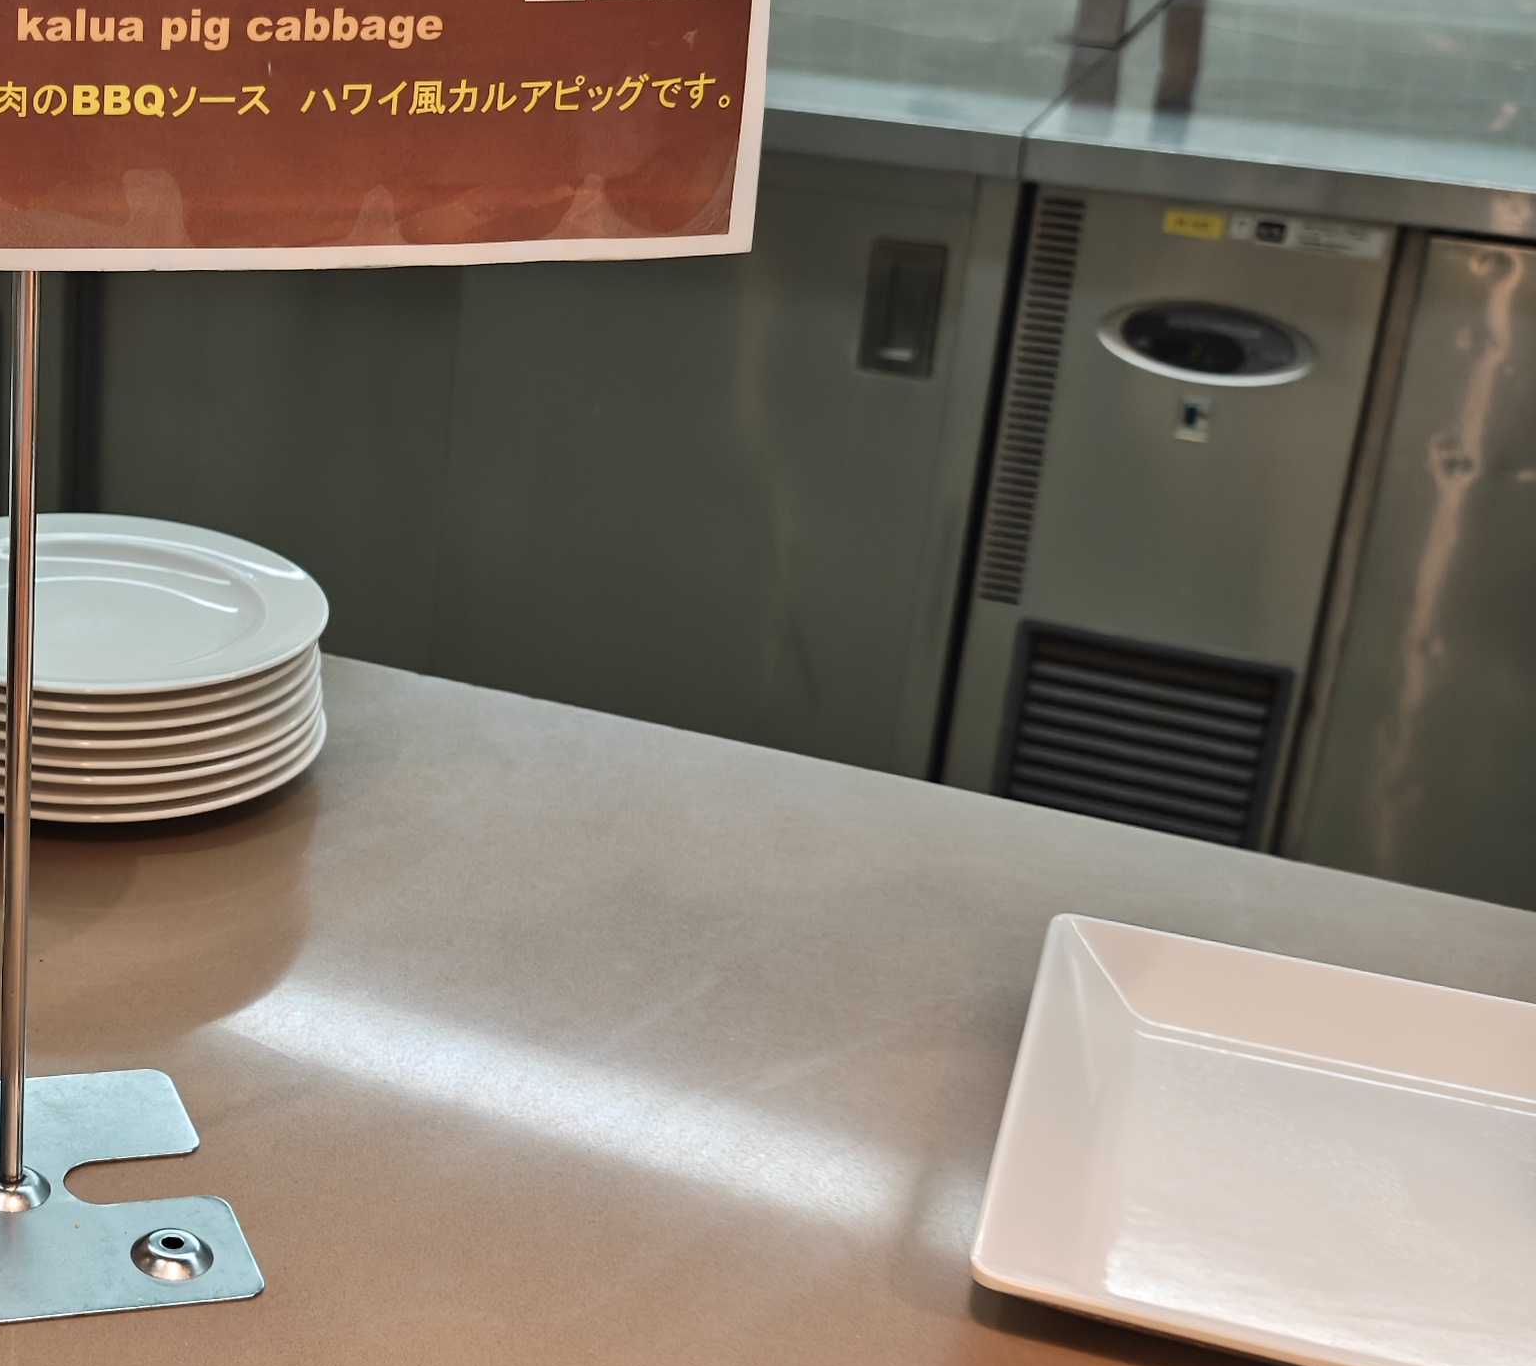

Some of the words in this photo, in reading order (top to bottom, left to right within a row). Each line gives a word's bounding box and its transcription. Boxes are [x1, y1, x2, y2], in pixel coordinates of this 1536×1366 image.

[17, 8, 144, 42] kalua
[160, 9, 230, 51] pig
[246, 8, 444, 50] cabbage
[300, 73, 732, 117] ハワイ風カルアピッグです。
